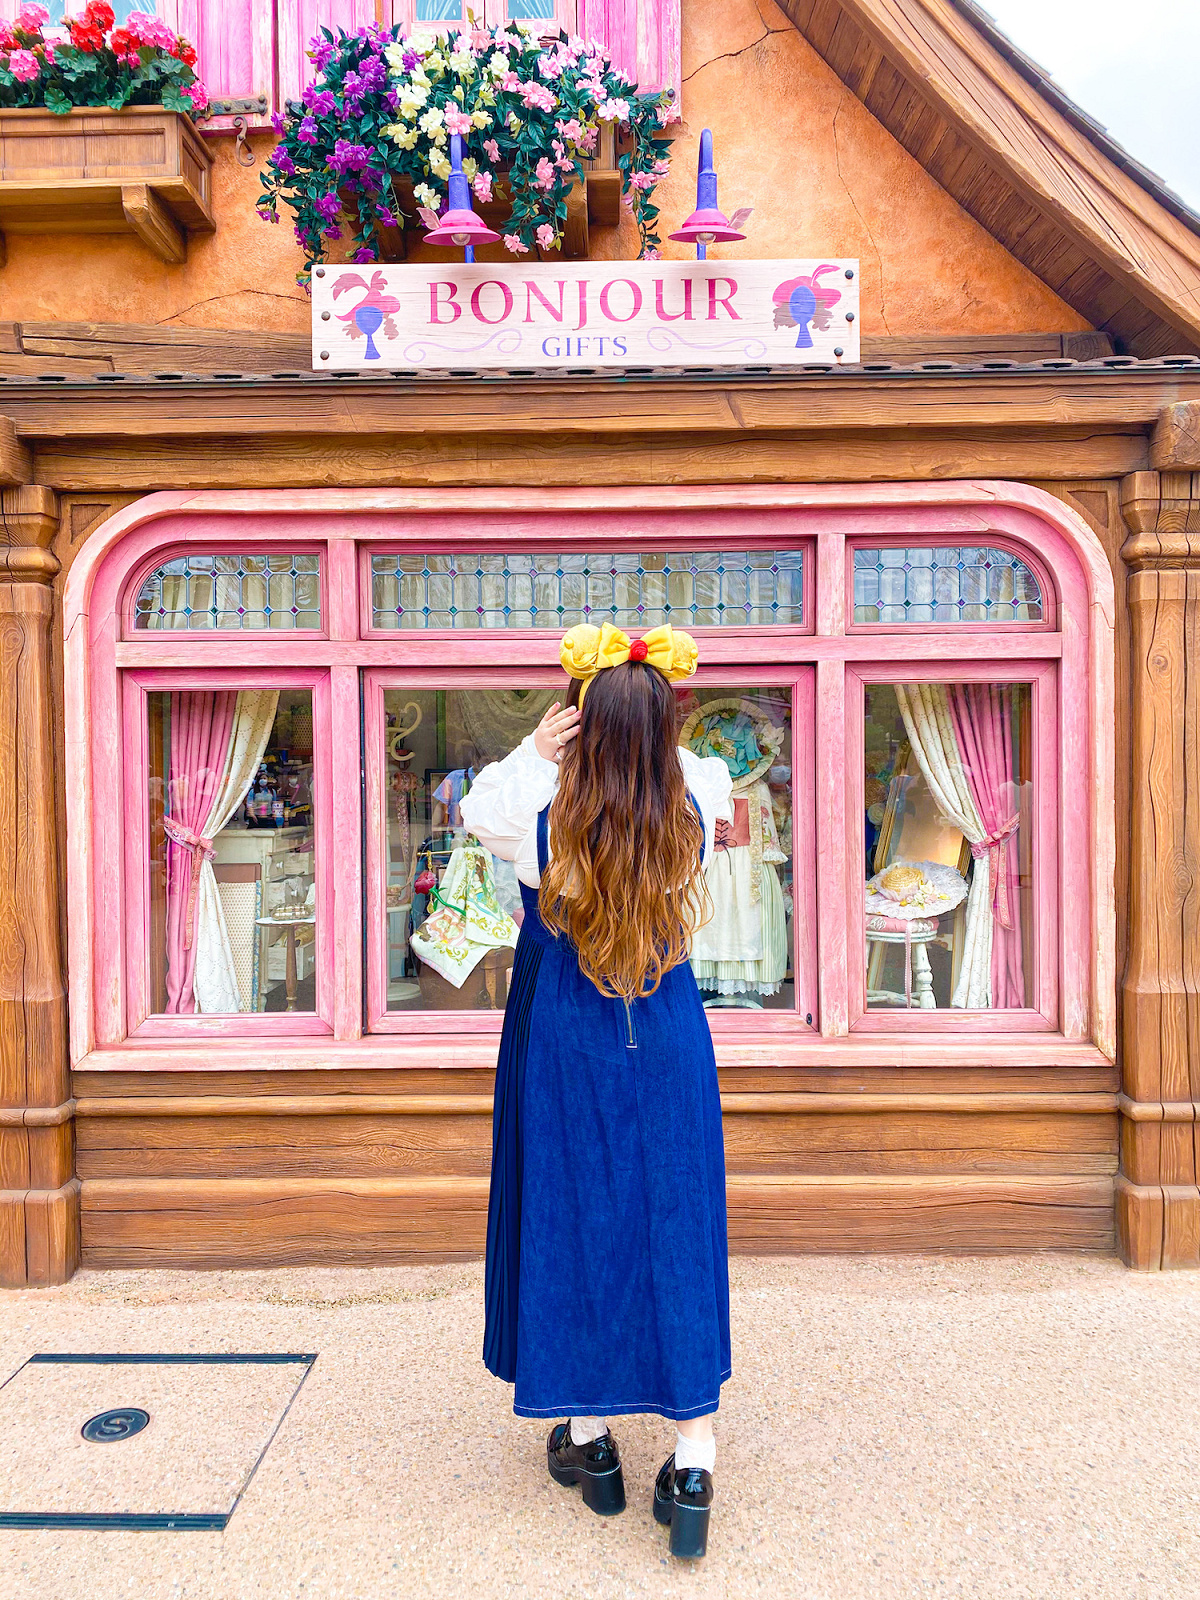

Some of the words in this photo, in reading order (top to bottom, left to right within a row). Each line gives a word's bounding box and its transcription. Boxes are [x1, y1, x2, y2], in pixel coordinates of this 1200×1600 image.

[427, 277, 743, 331] BONJOUR
[541, 336, 628, 357] GIFTS
[95, 1415, 134, 1438] S
